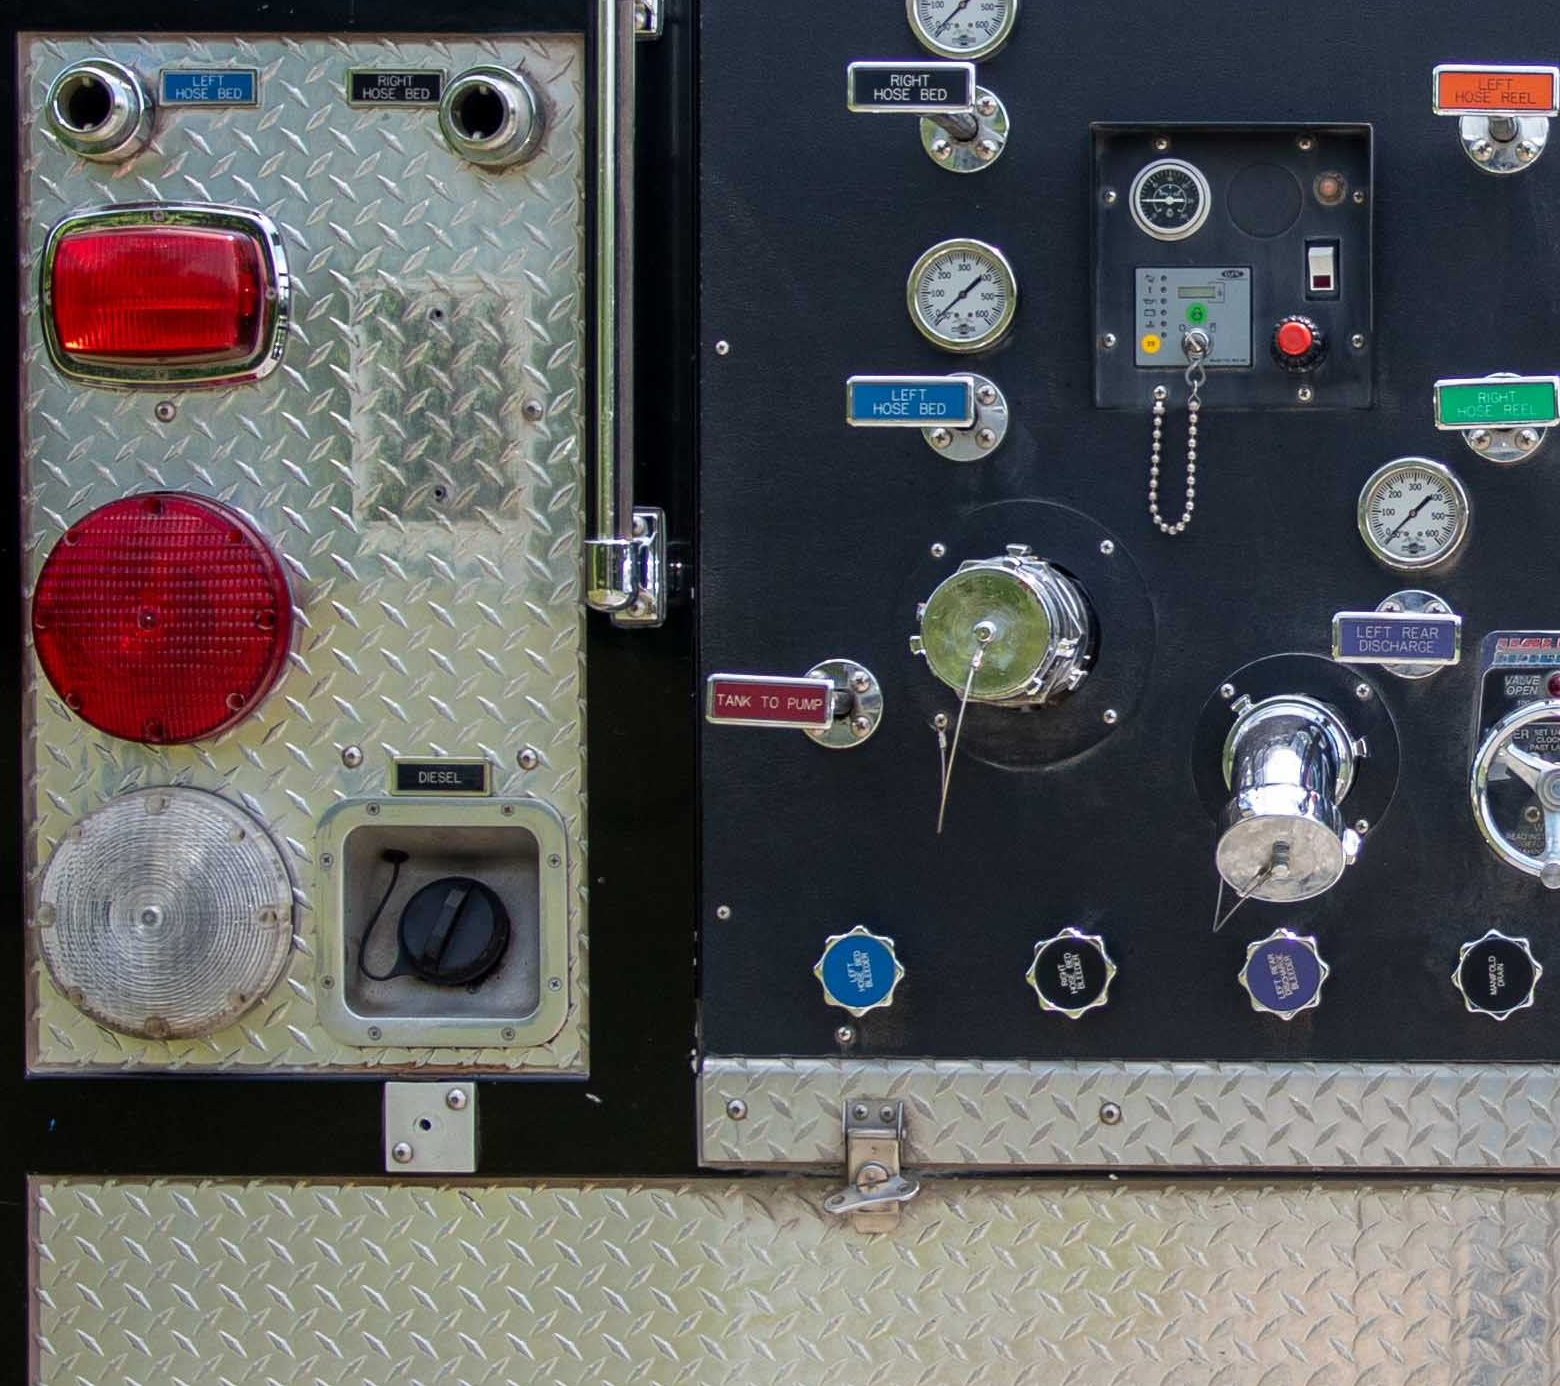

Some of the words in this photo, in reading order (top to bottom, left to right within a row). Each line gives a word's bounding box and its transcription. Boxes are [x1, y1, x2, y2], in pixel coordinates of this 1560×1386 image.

[930, 0, 945, 9] 100
[980, 3, 995, 12] 500
[975, 20, 990, 30] 600
[192, 75, 225, 87] LEFT
[377, 75, 414, 87] RIGHT
[890, 74, 930, 87] RIGHT
[1478, 78, 1513, 91] LEFT
[175, 88, 209, 100] HOSE
[217, 88, 242, 100] BED
[362, 88, 397, 100] HOSE
[405, 88, 430, 100] BED
[873, 88, 911, 101] HOSE
[920, 88, 948, 101] BED
[1454, 91, 1491, 103] HOSE
[1500, 92, 1537, 105] REEL
[957, 263, 971, 272] 300
[937, 271, 952, 280] 200
[931, 289, 945, 298] 100
[980, 292, 995, 301] 500
[975, 309, 989, 319] 600
[891, 388, 927, 402] LEFT
[1477, 390, 1517, 404] RIGHT
[872, 402, 910, 415] HOSE
[919, 402, 947, 415] BED
[1456, 405, 1492, 418] HOSE
[1503, 404, 1537, 417] REEL
[1408, 483, 1422, 492] 300
[1388, 490, 1402, 499] 200
[1381, 508, 1396, 517] 100
[1431, 512, 1445, 521] 500
[1425, 529, 1439, 538] 600
[1356, 626, 1392, 638] LEFT
[1401, 626, 1439, 638] REAR
[1358, 639, 1435, 653] DISCHARGE
[1504, 675, 1541, 686] VALVE
[1506, 686, 1539, 696] OPEN
[716, 693, 752, 708] TANK
[760, 695, 779, 709] TO
[787, 697, 824, 711] PUMP
[418, 771, 462, 784] DIESEL
[1063, 952, 1073, 969] BED
[1487, 955, 1497, 996] MANIFOLD
[1496, 963, 1505, 987] DRAIN
